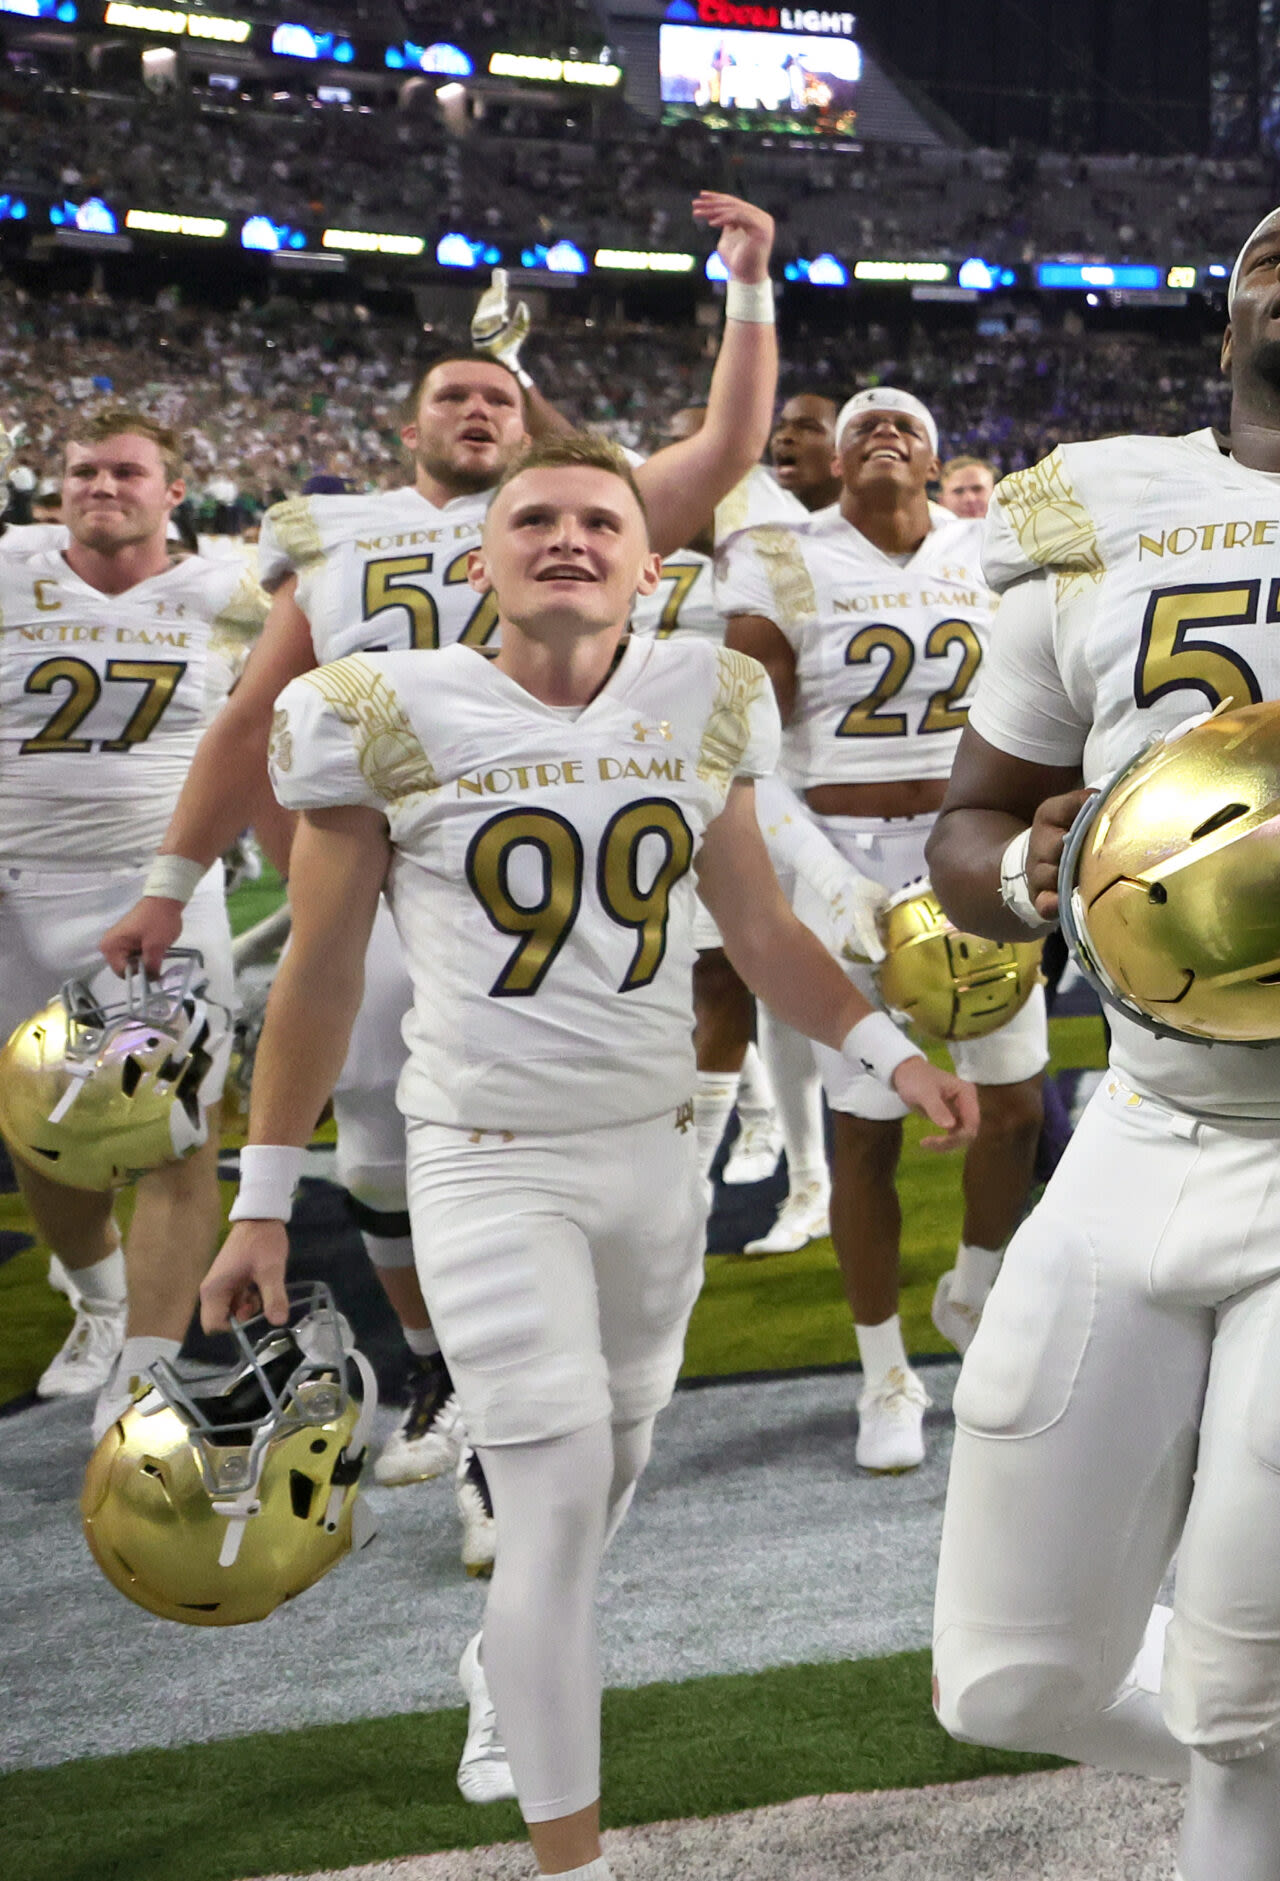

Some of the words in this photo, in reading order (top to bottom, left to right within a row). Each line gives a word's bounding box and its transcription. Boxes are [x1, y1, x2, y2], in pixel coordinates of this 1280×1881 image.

[780, 8, 856, 34] LIGHT
[355, 527, 444, 554] NOTRE
[1138, 520, 1280, 561] NOTRE
[33, 579, 61, 611] C
[833, 591, 910, 613] NOTRE
[920, 590, 979, 607] DAME
[18, 625, 107, 642] NOTRE
[117, 628, 192, 648] DAME
[835, 618, 982, 737] 22
[19, 656, 187, 755] 27
[456, 760, 584, 798] NOTRE
[598, 757, 686, 782] DAME
[465, 797, 693, 997] 99
